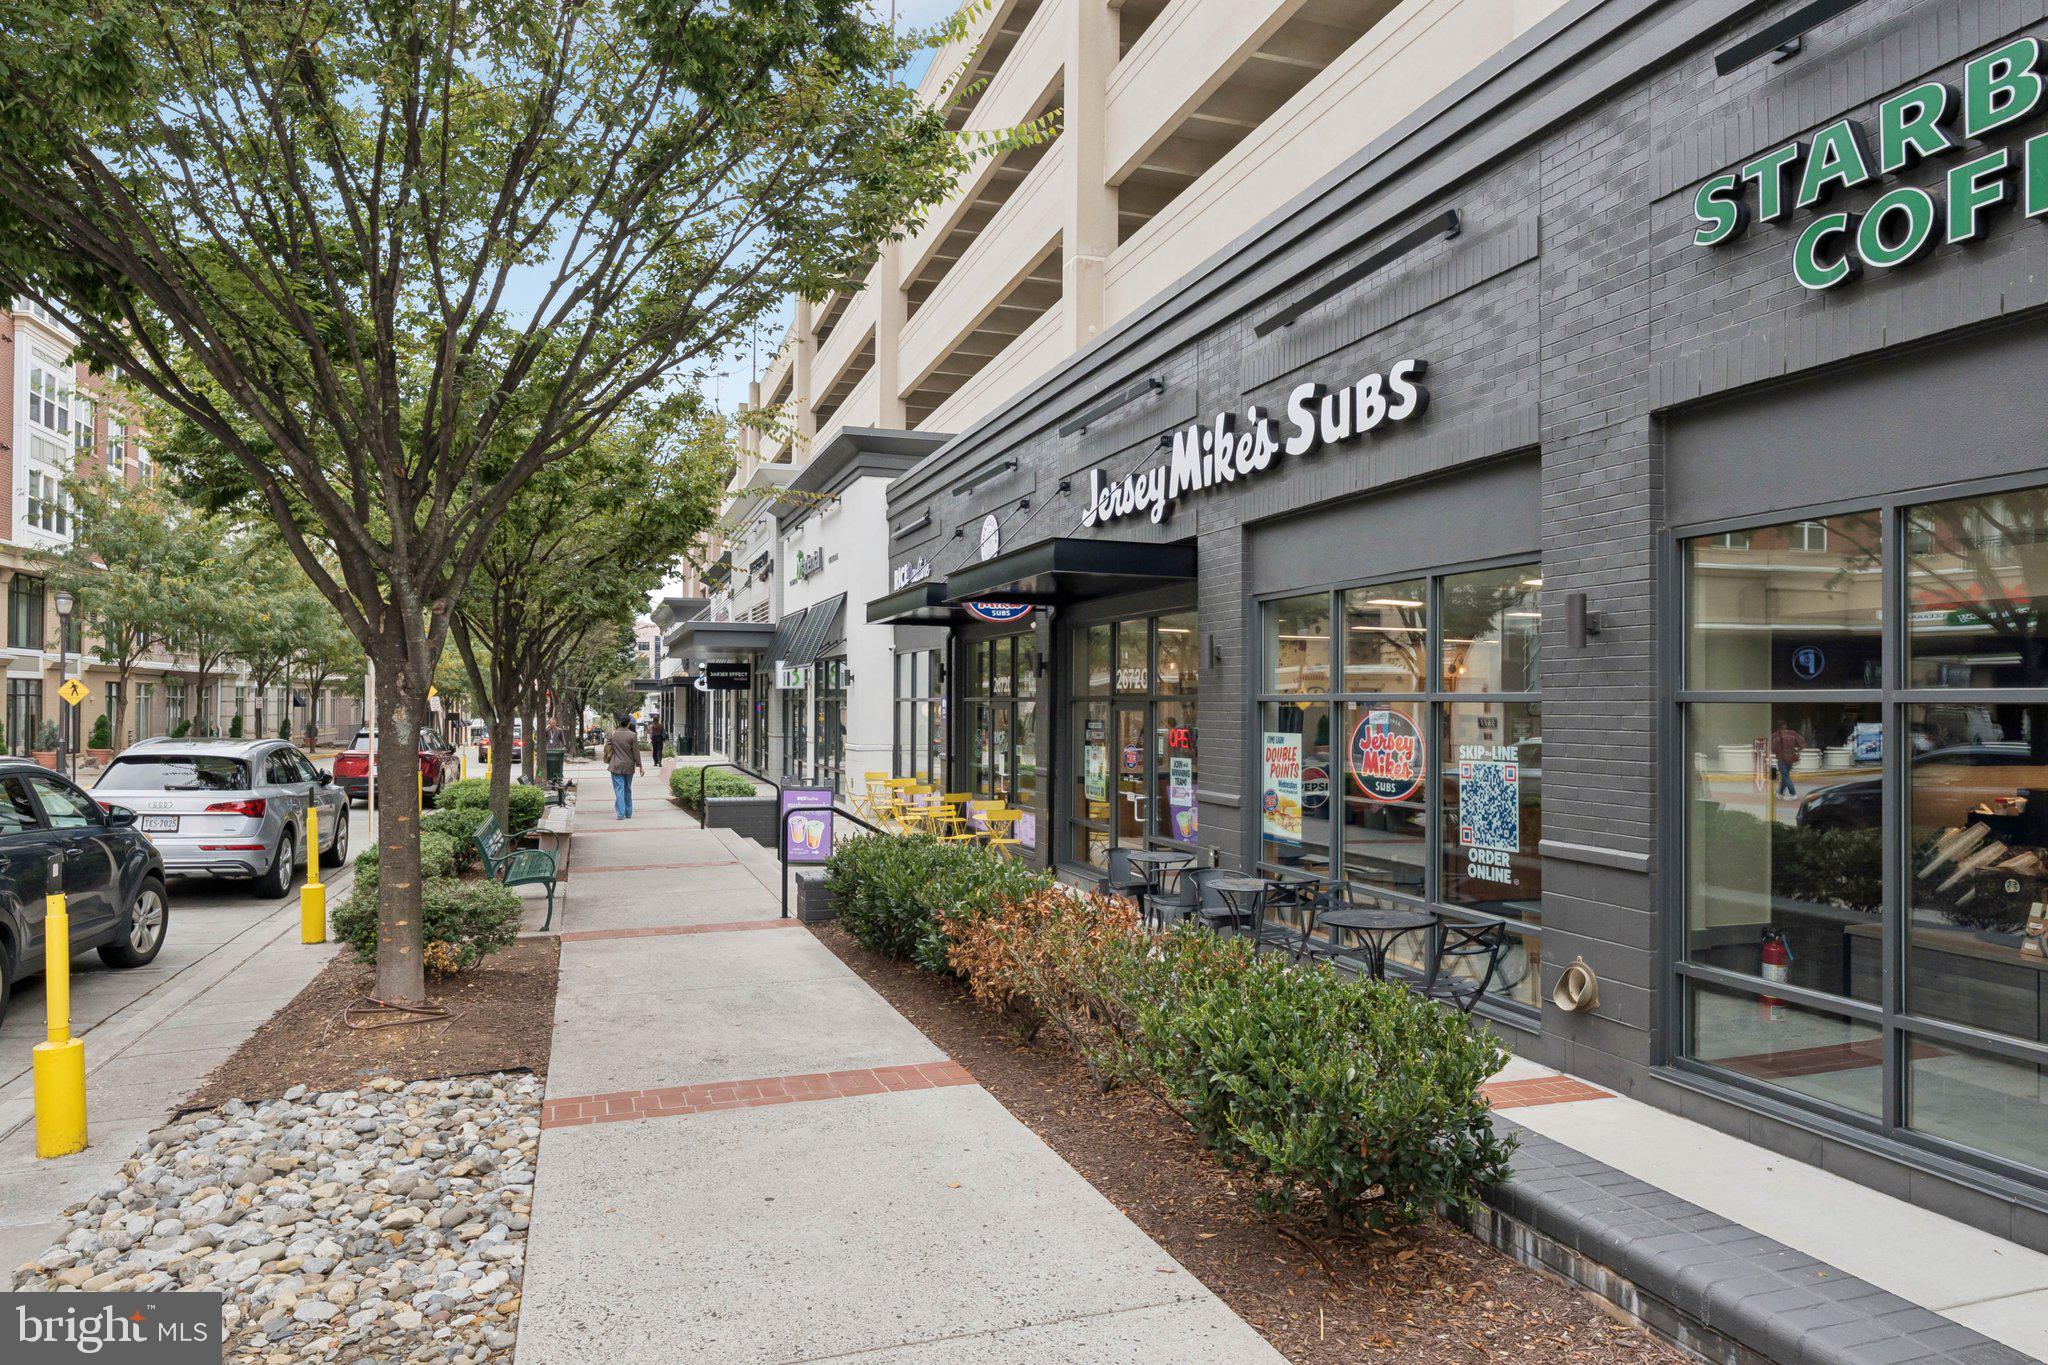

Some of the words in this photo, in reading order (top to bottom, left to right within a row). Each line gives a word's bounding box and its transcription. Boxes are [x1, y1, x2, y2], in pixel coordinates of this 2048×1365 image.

[1693, 37, 2043, 246] STARB
[1083, 466, 1170, 527] Jersey
[1169, 406, 1278, 498] Mike's
[1286, 360, 1418, 455] SUBS
[1359, 725, 1415, 761] Jersey
[1460, 745, 1484, 760] SKIP
[1492, 746, 1518, 761] LINE
[1265, 746, 1298, 762] DOUBLE
[1269, 762, 1299, 778] POINTS
[1361, 750, 1414, 781] Mike's
[1375, 781, 1396, 792] SUBS
[1468, 848, 1510, 867] ORDER
[1467, 863, 1511, 884] ONLINE
